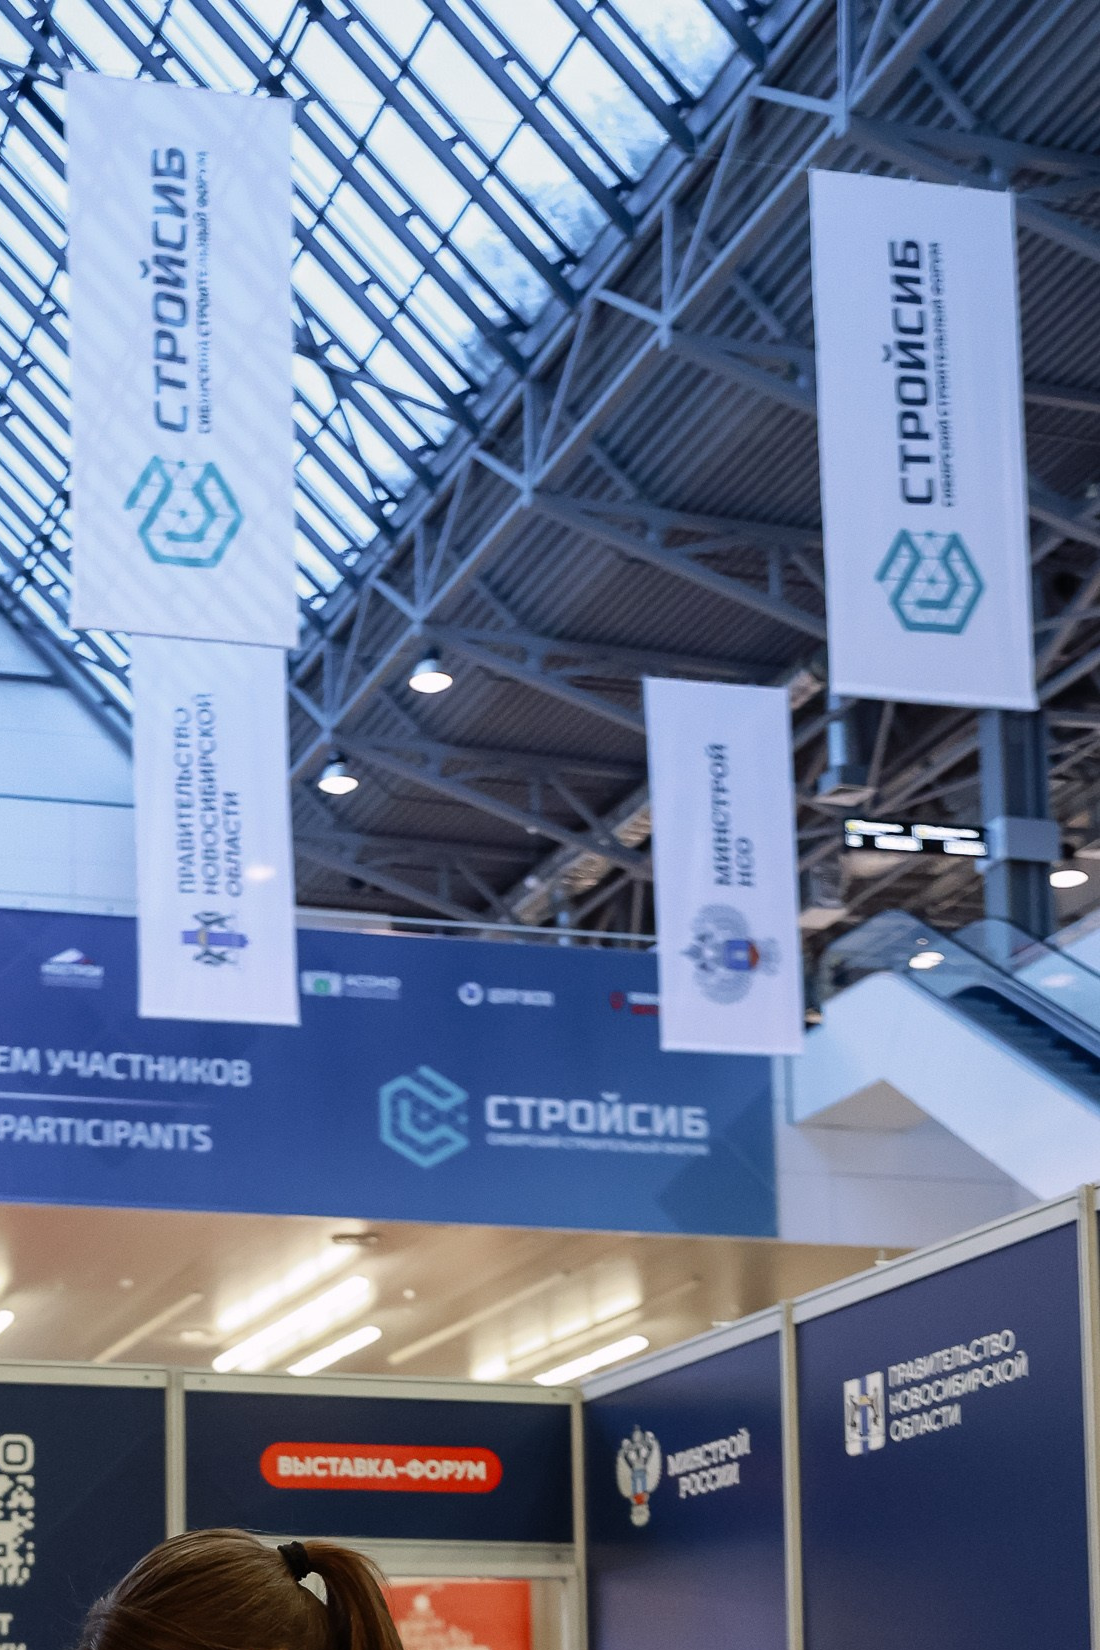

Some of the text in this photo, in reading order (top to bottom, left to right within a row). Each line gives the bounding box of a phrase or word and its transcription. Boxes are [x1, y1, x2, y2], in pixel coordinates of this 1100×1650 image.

[139, 147, 189, 432] СТРОЙСИБ
[881, 239, 935, 505] СТРОЙСИБ
[174, 707, 196, 893] ПРАВИТЕЛЬСТВО
[192, 693, 221, 895] НОВОСИБИРСКОЙ
[222, 791, 243, 897] ОБЛАСТИ
[45, 1048, 252, 1087] УЧАСТНИКОВ
[485, 1091, 710, 1139] СТРОЙСИБ
[888, 1329, 1016, 1387] ПРАВИТЕЛЬСТВО
[889, 1350, 1029, 1414] НОВОСИБИРСКОЙ
[666, 1427, 751, 1476] МИНСТРОЙ
[890, 1404, 962, 1442] ОБЛАСТИ
[277, 1455, 487, 1481] ВЫСТАВКА-ФОРУМ
[678, 1461, 740, 1498] РОССИИ
